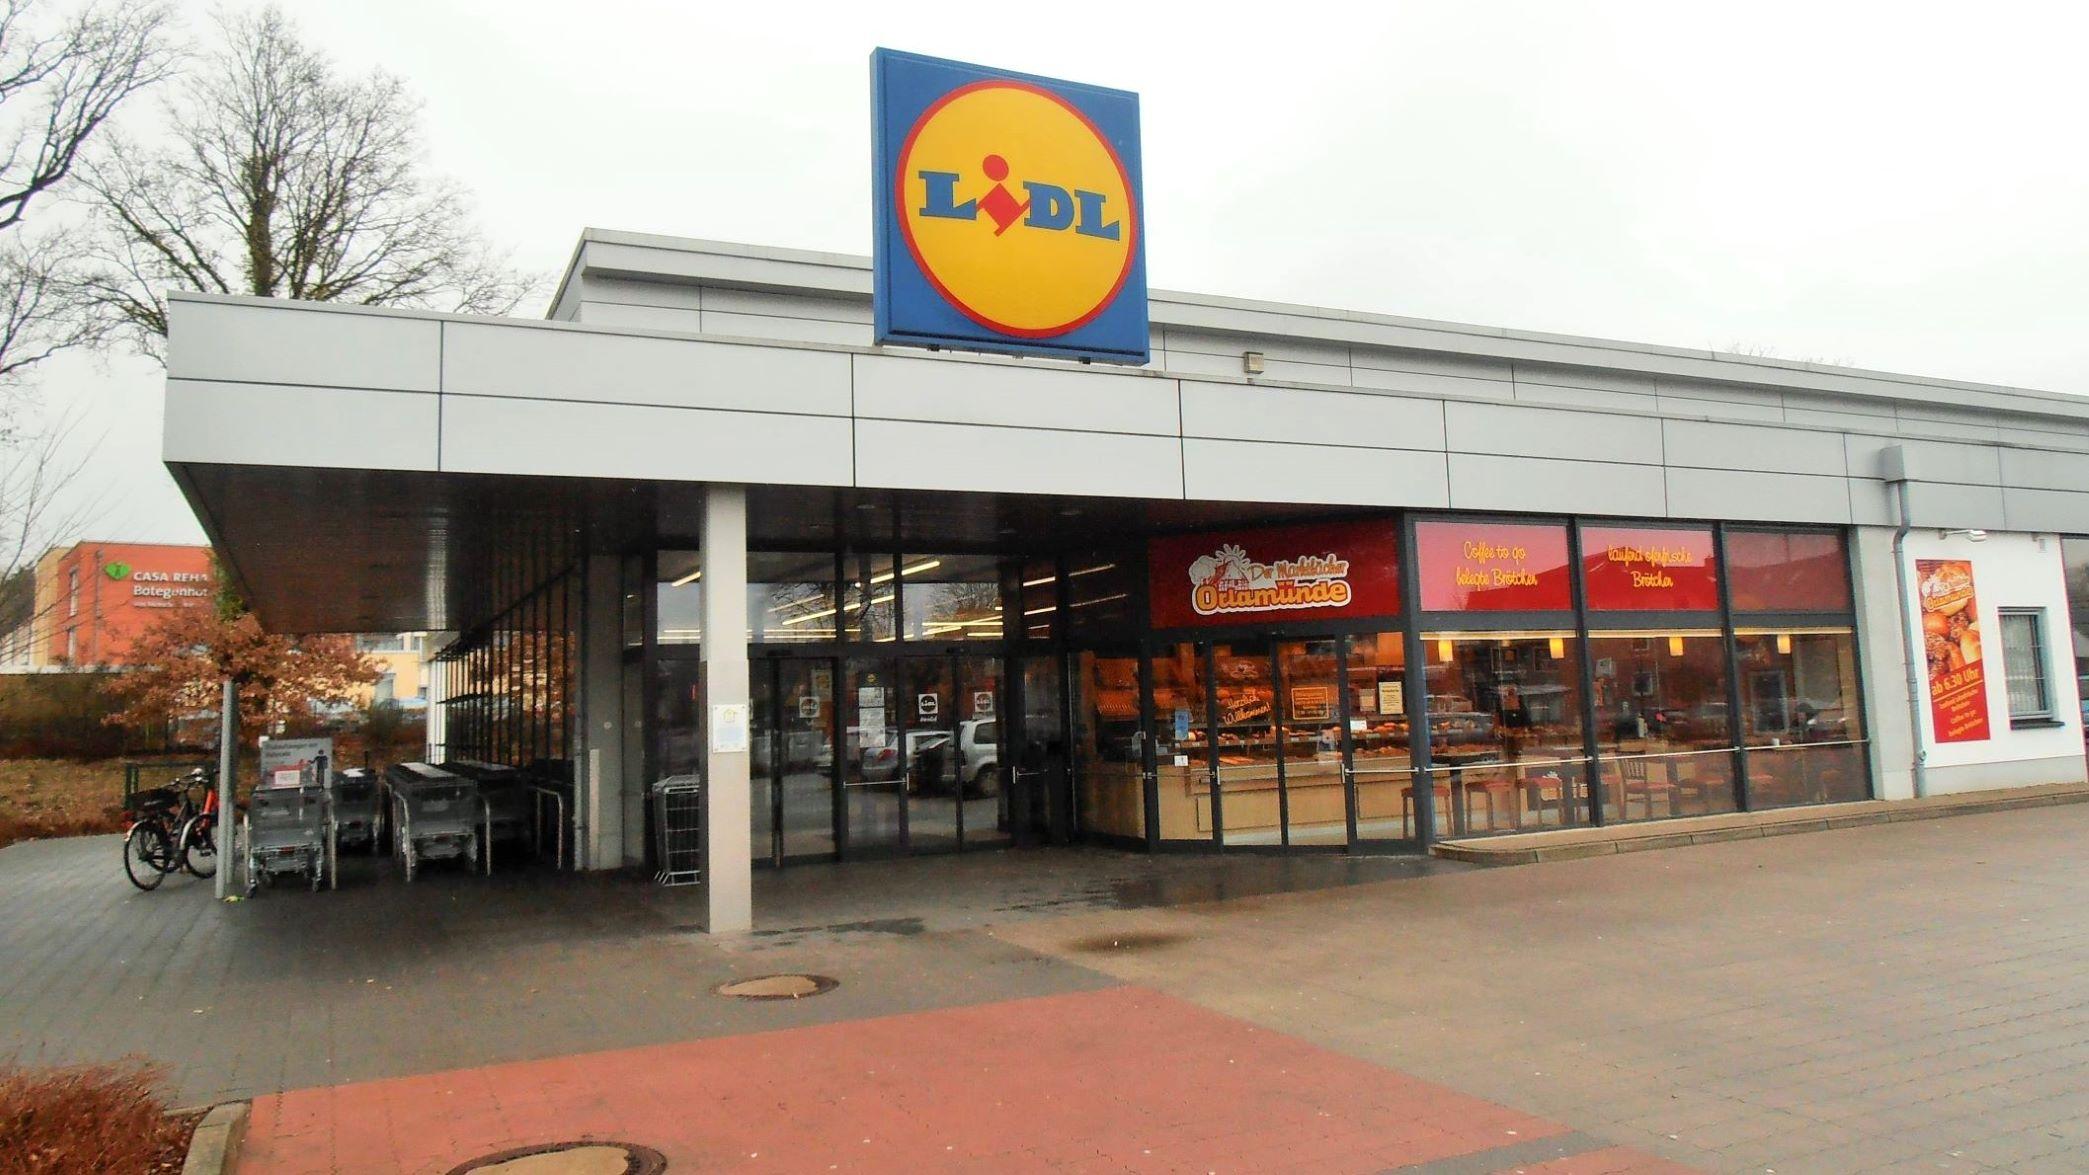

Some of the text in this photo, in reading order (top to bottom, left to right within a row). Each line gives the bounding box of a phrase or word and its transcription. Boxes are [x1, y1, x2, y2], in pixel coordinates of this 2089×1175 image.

[918, 154, 1120, 241] LIDL
[1463, 541, 1526, 565] Coffee to go
[133, 572, 169, 582] CASA
[1249, 564, 1274, 580] Der
[1456, 567, 1538, 591] belegte Brötchen
[1630, 570, 1673, 588] Brötchen
[1932, 667, 1979, 696] ab 6.30 Uhr
